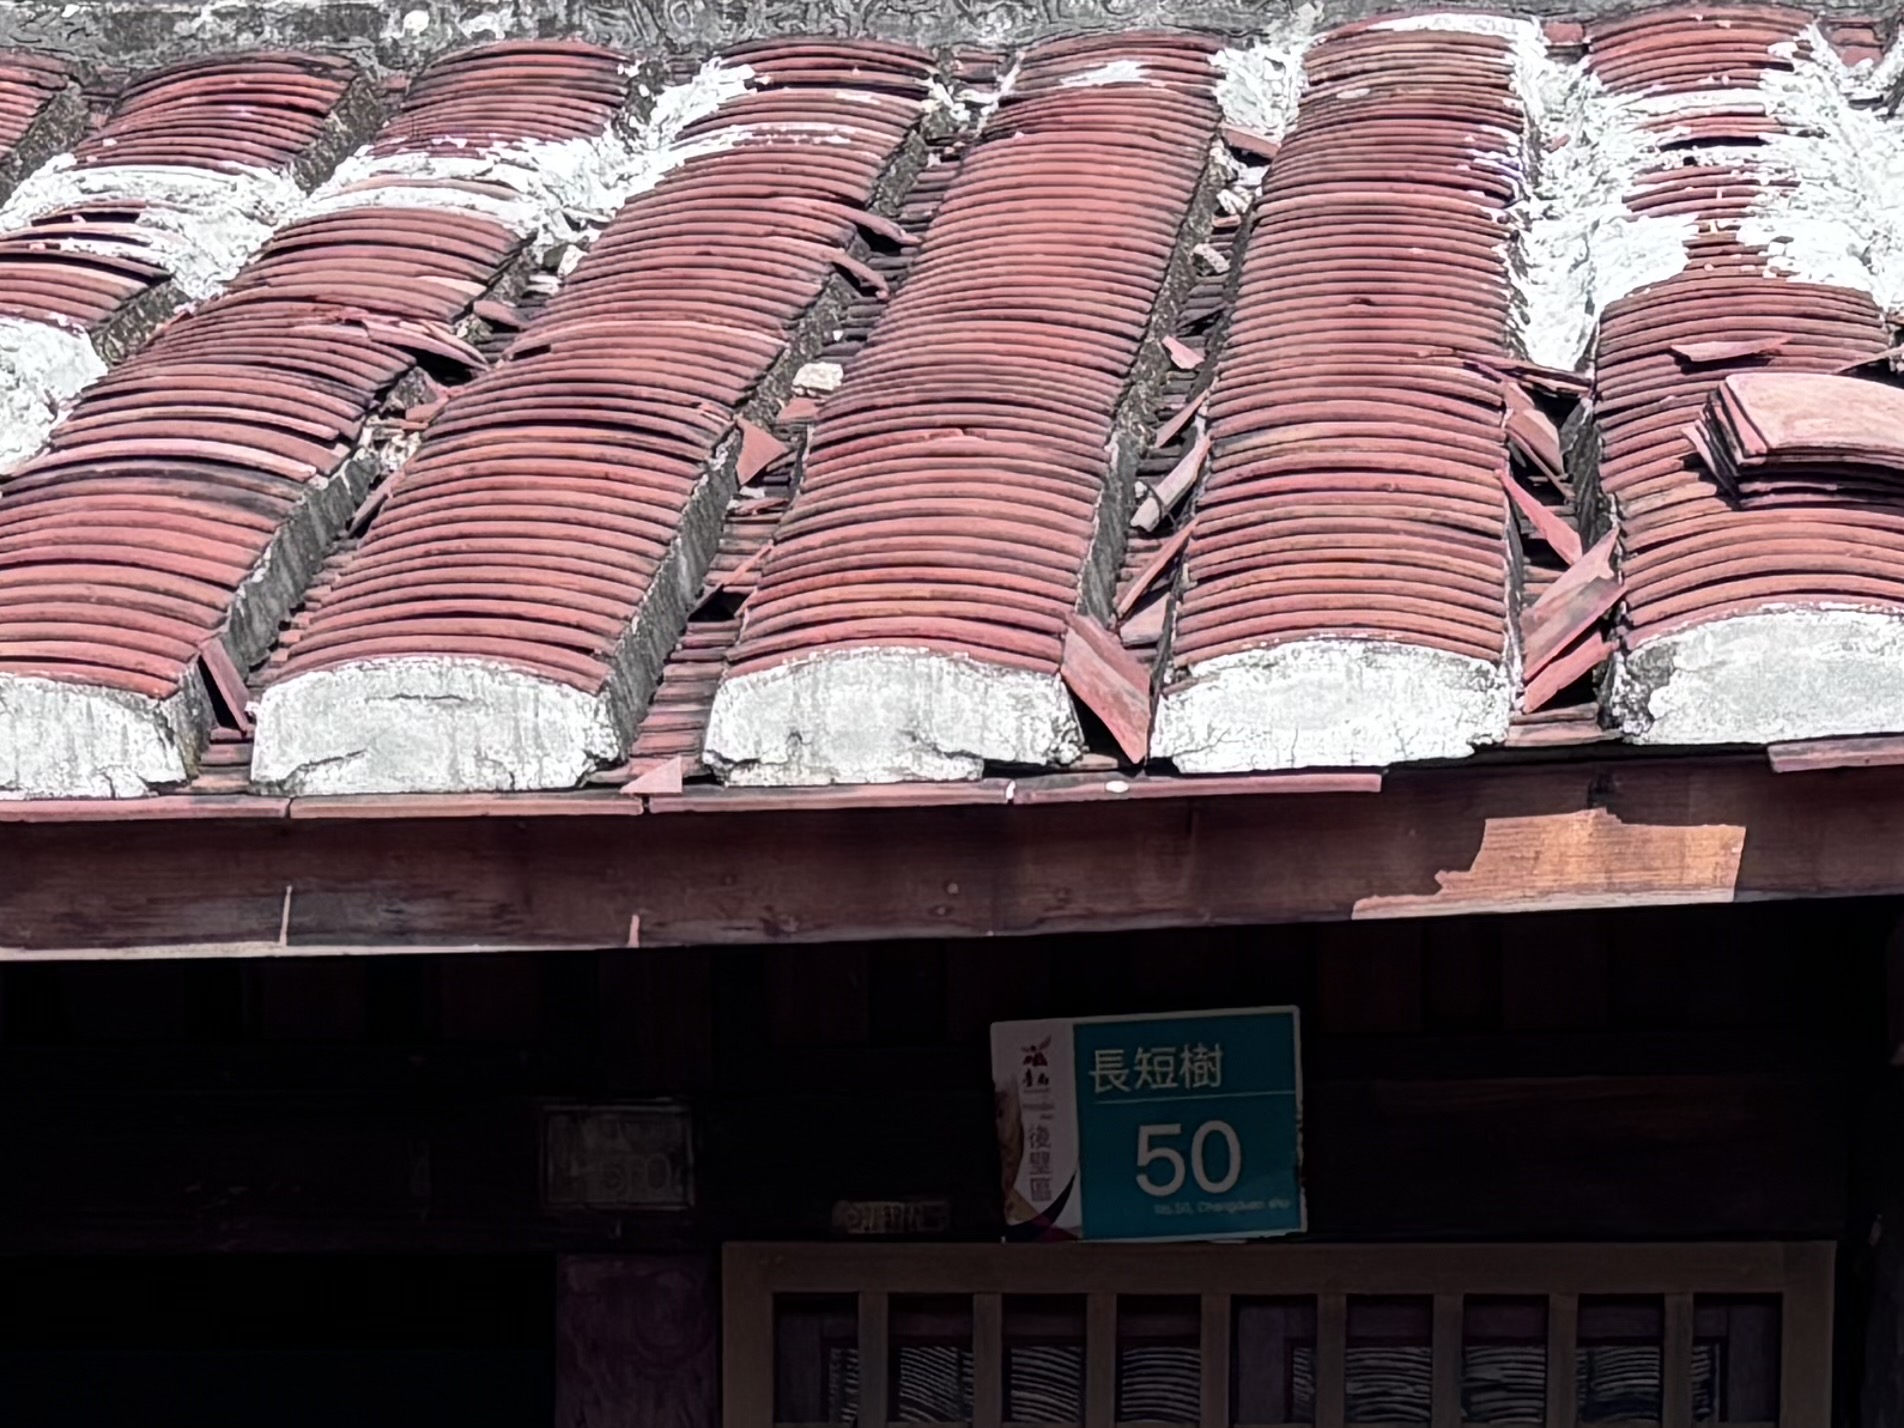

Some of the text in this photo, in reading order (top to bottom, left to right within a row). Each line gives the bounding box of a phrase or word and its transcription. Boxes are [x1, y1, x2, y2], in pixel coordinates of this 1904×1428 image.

[1088, 1043, 1224, 1093] 長短樹
[1135, 1119, 1242, 1197] 50
